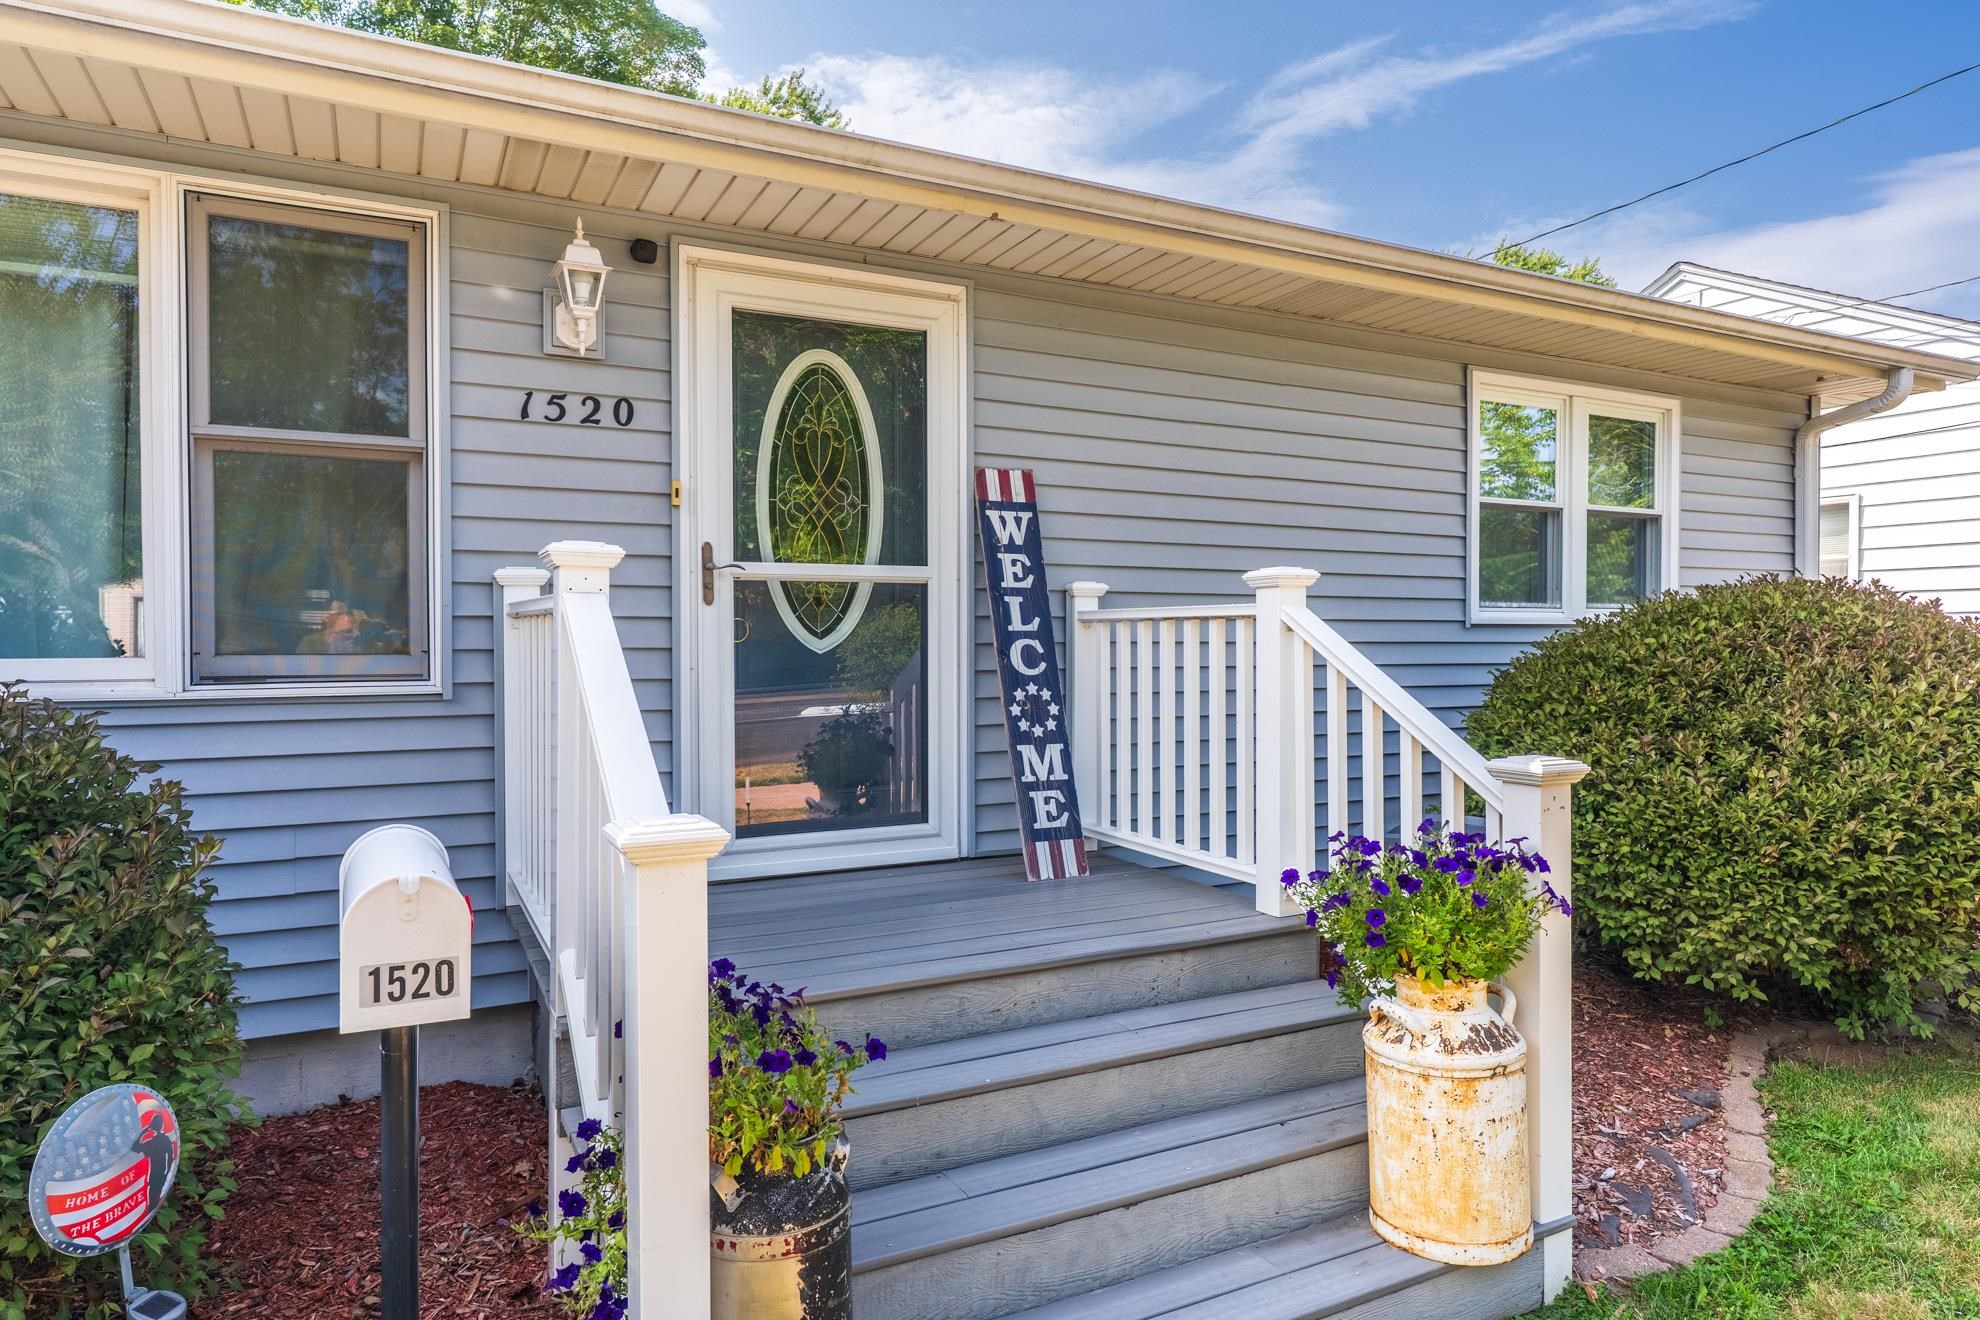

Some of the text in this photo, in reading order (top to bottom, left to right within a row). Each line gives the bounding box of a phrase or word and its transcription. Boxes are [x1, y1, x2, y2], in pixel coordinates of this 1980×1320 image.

[520, 391, 634, 427] 1520
[367, 959, 455, 1004] 1520
[65, 1170, 136, 1209] HOME OF
[70, 1190, 145, 1238] THE BRAVE
